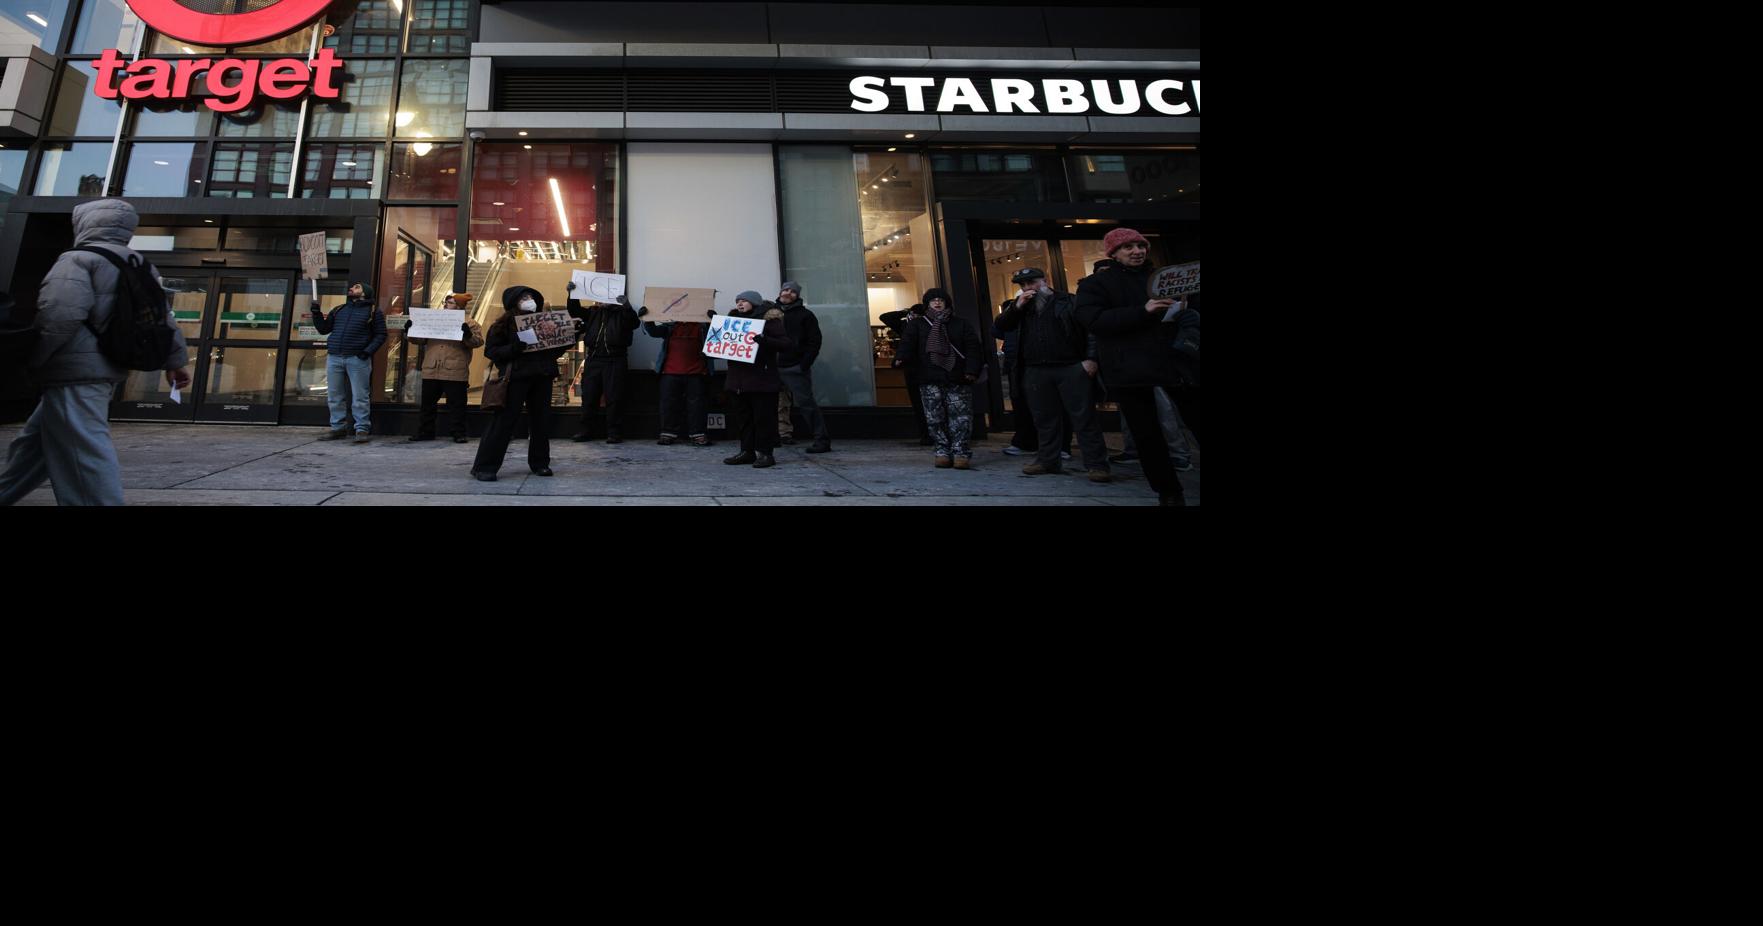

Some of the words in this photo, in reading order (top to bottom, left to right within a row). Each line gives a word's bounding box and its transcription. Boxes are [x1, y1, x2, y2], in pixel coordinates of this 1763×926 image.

[90, 48, 344, 113] target
[849, 75, 1200, 115] STARBUC
[583, 276, 621, 300] ICE
[522, 313, 566, 326] TARGET
[724, 318, 753, 333] ICE
[723, 332, 744, 342] out
[706, 341, 754, 359] target
